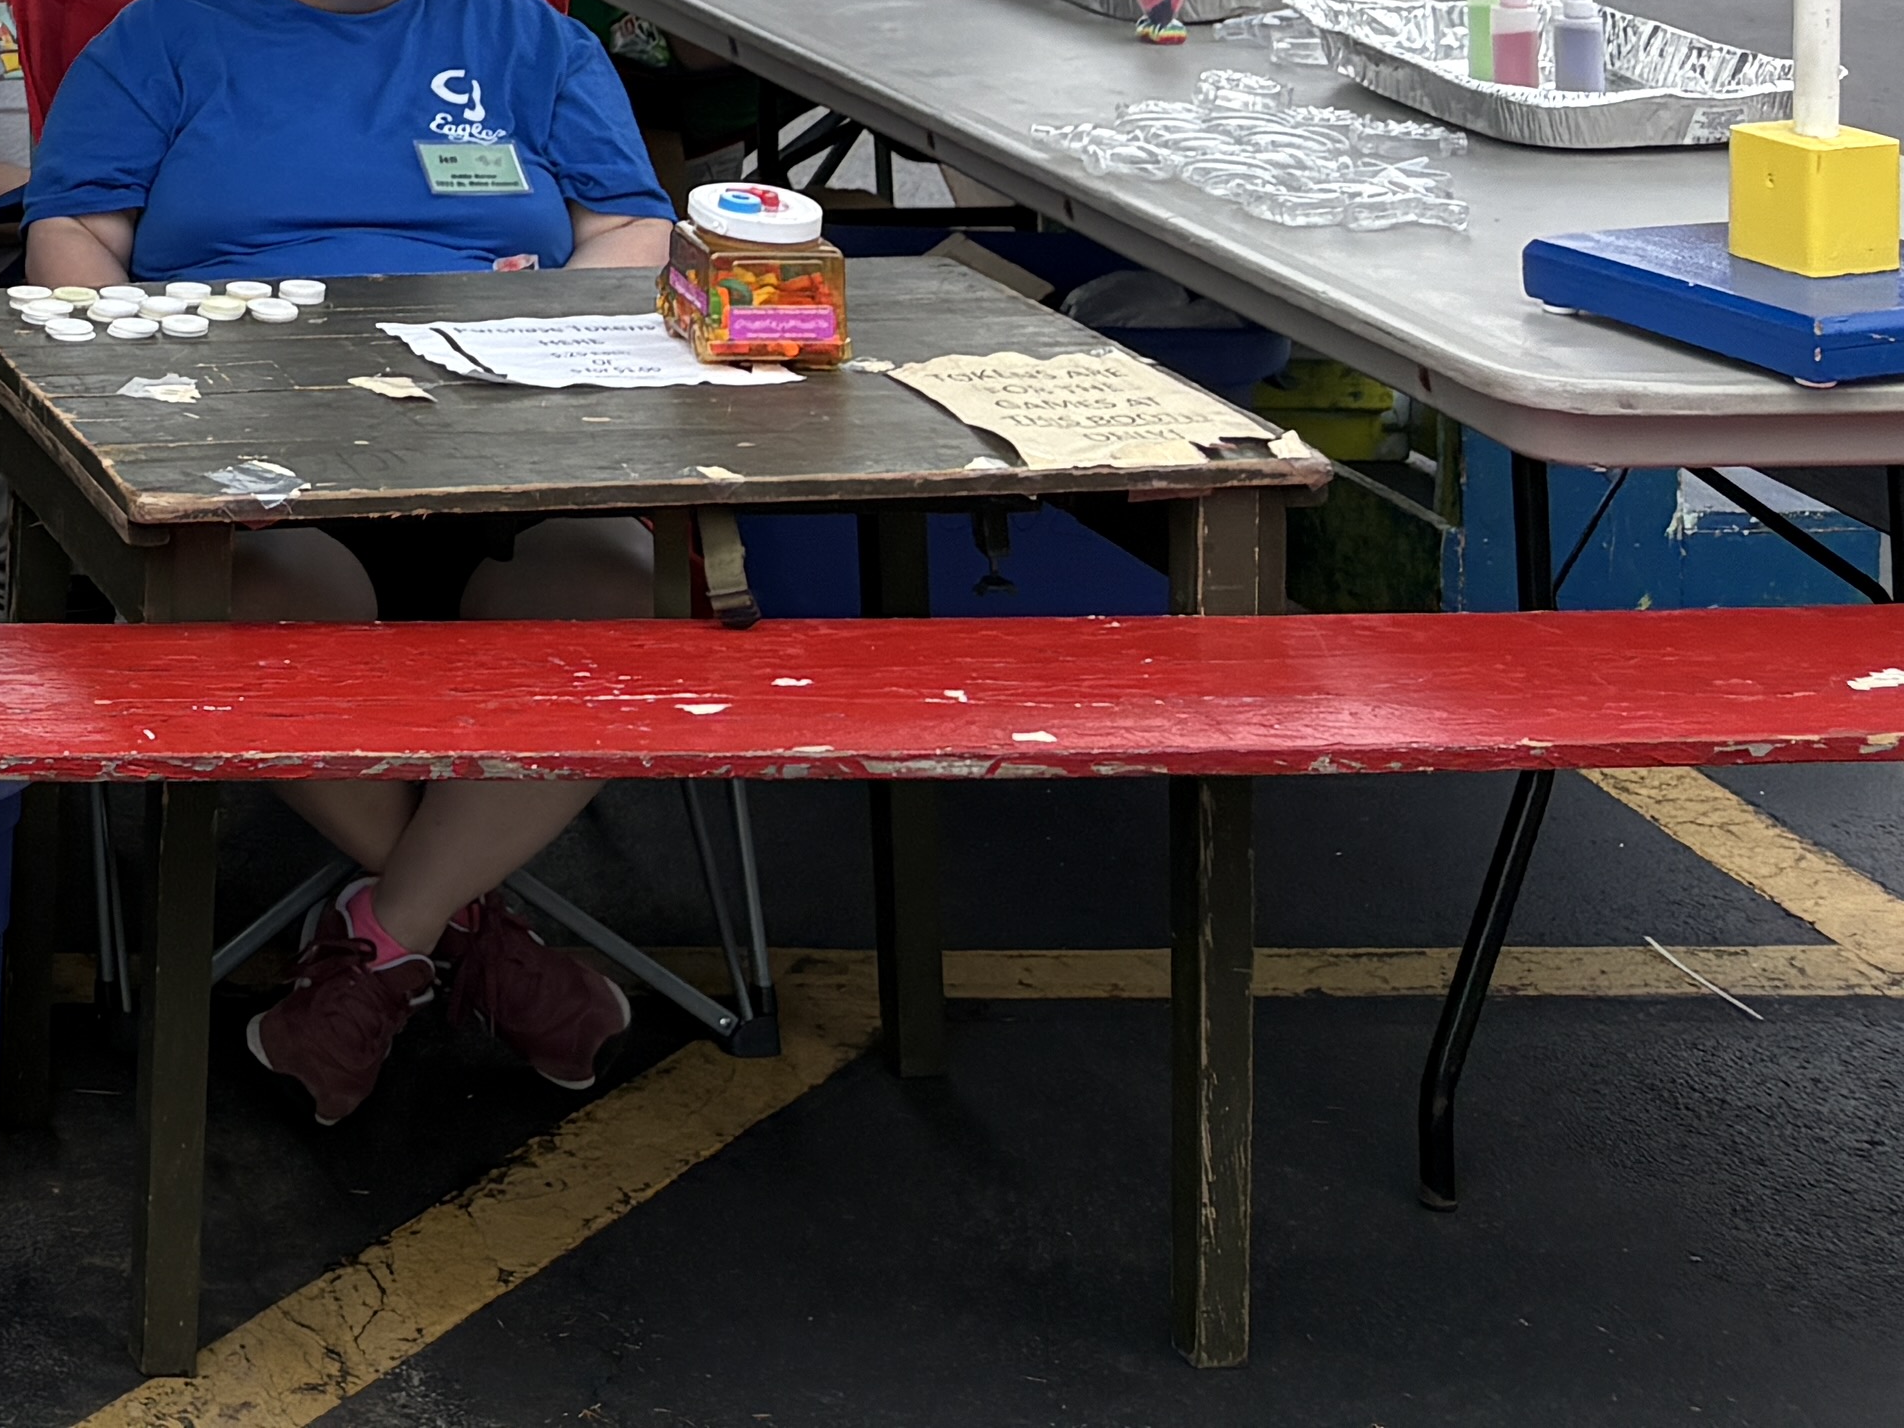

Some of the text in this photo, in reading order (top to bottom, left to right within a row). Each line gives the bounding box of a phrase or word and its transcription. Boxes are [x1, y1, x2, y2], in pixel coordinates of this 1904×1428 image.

[429, 111, 508, 144] Eagles
[925, 365, 1128, 384] TOKENS ARE
[1060, 381, 1123, 395] THE
[994, 396, 1162, 411] GAMES AT
